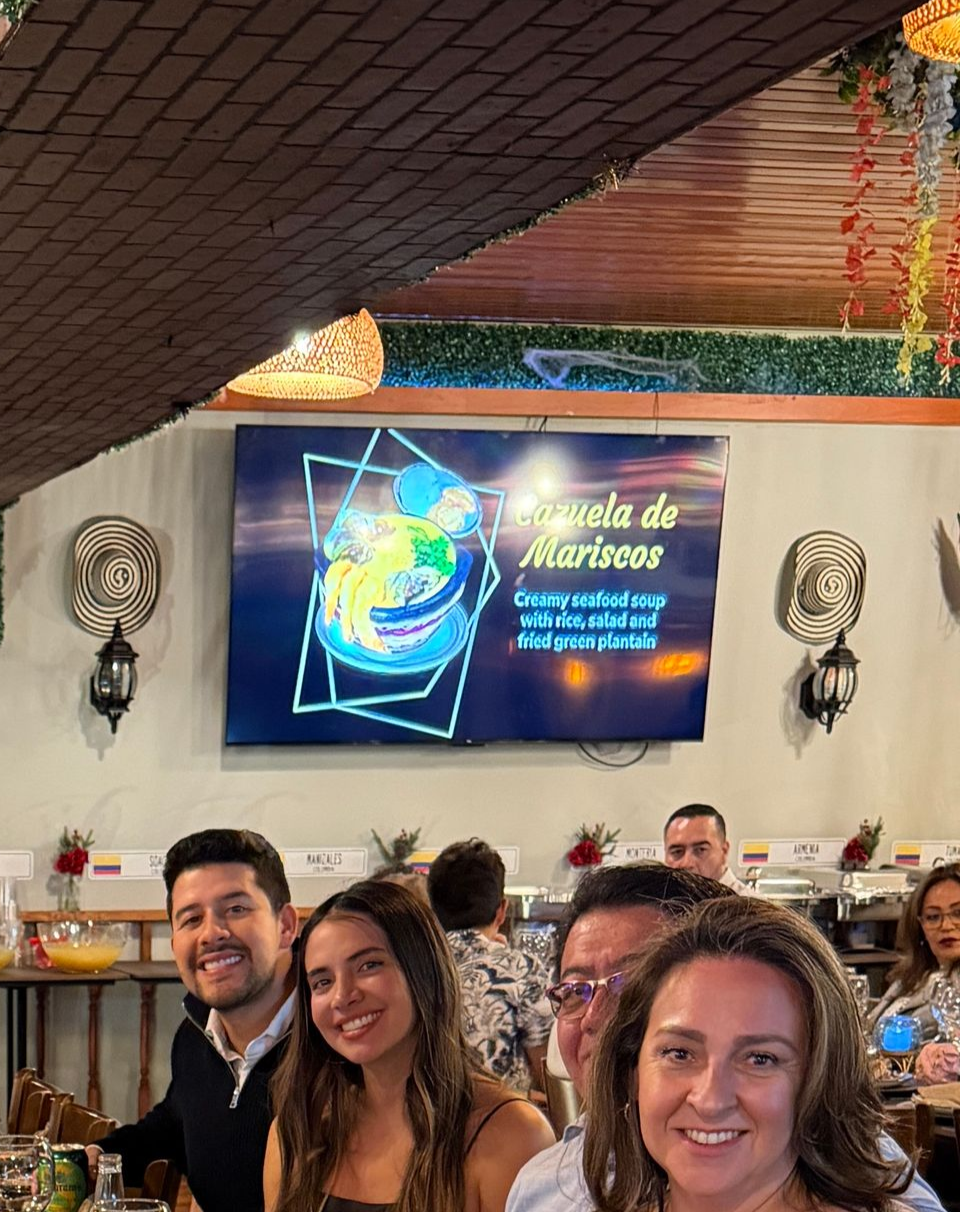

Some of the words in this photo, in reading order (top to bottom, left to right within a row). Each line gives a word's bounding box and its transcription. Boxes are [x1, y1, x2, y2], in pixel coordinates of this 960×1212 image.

[515, 491, 633, 529] Cazuela
[641, 492, 678, 529] de
[519, 535, 664, 570] Mariscos
[514, 590, 571, 610] Creamy
[571, 589, 629, 608] seafood
[631, 592, 667, 610] soup
[520, 610, 553, 628] with
[555, 611, 586, 630] rice,
[588, 611, 627, 628] salad
[629, 611, 657, 628] and
[517, 632, 553, 649] fried
[554, 635, 596, 652] green
[598, 632, 657, 652] plantain
[306, 852, 342, 866] MANIZALES
[793, 843, 819, 855] ARMENIA
